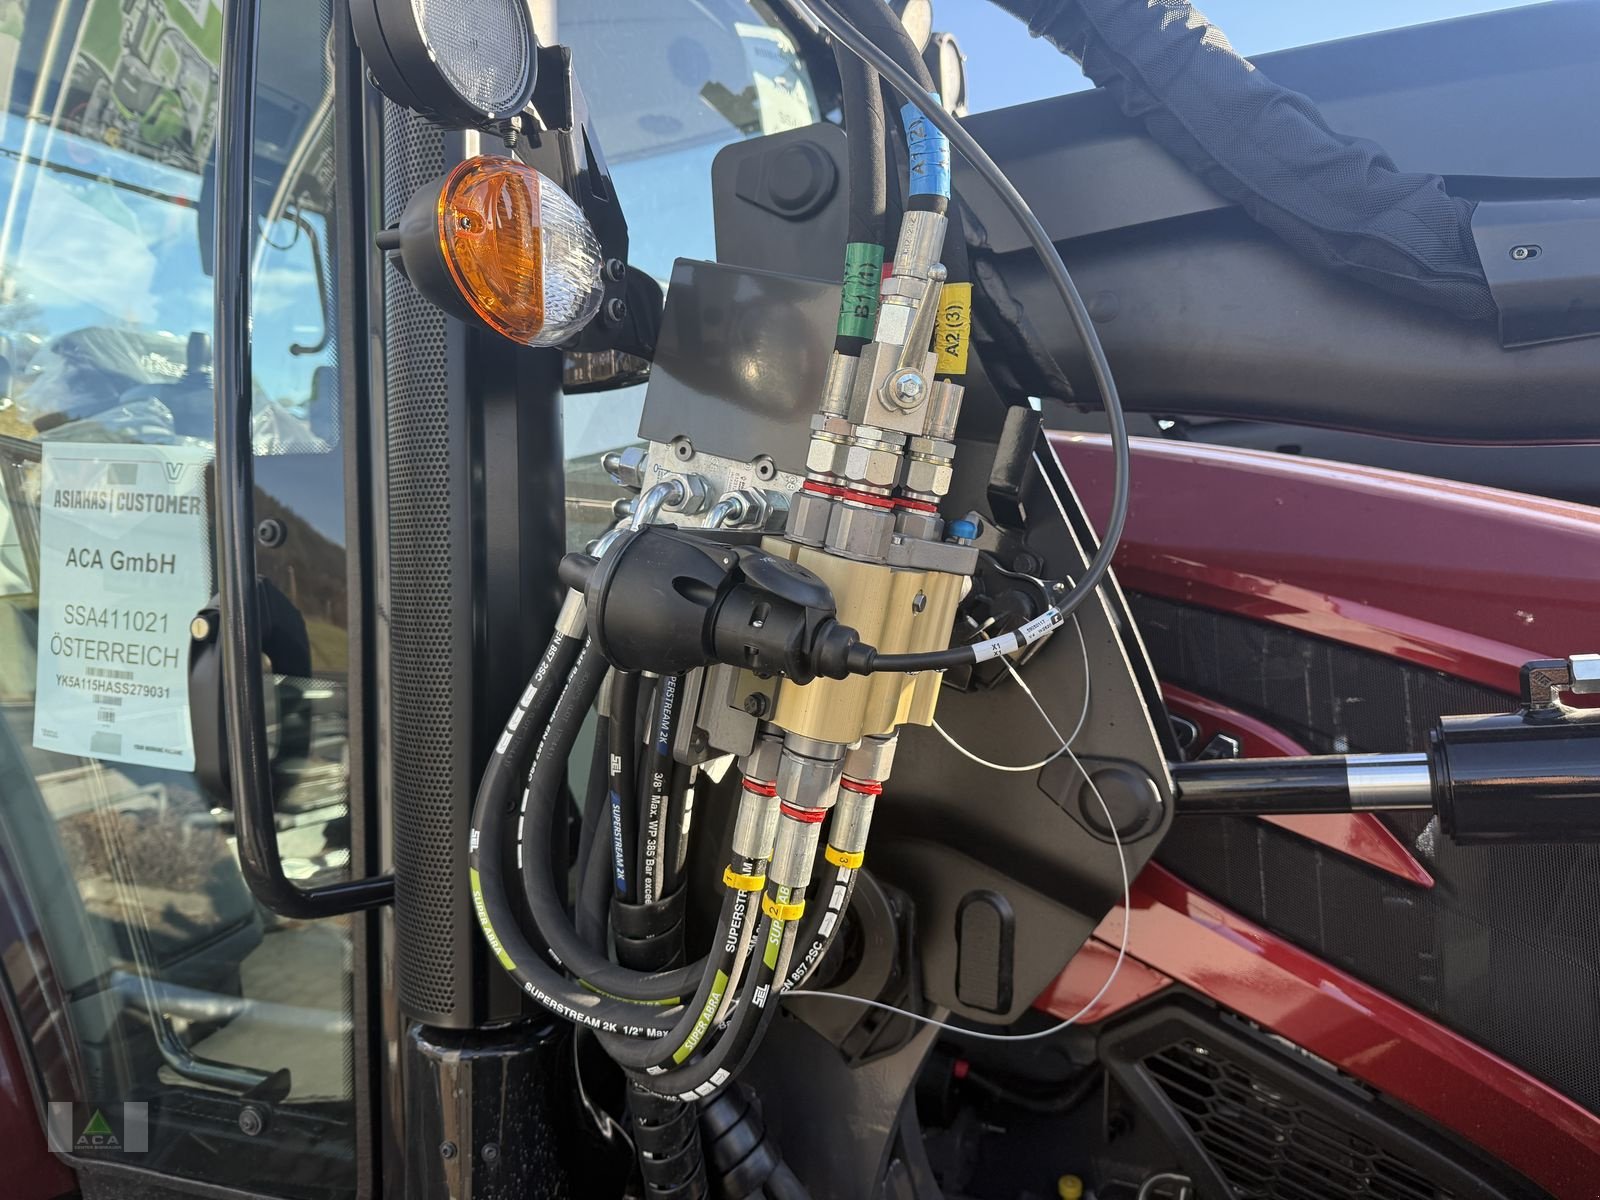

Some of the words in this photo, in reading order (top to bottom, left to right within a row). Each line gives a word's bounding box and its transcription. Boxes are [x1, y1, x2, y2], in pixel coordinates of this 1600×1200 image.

[910, 151, 925, 175] A1
[854, 294, 871, 319] B1
[945, 305, 964, 328] (3)
[945, 333, 960, 357] A2
[116, 492, 201, 515] CUSTOMER
[65, 547, 104, 569] ACA
[110, 550, 177, 574] GmbH
[63, 604, 168, 633] SSA411021
[50, 632, 179, 669] ÖSTERREICH
[546, 645, 558, 662] 857
[991, 642, 1002, 651] X1
[535, 661, 549, 682] 2SC
[661, 676, 677, 731] PERSTREAM
[659, 731, 669, 744] 2K
[610, 753, 622, 777] SEL
[653, 772, 664, 792] 3/8"
[649, 795, 661, 818] Max.
[613, 803, 624, 867] SUPERSTREAM
[648, 820, 658, 837] WP
[646, 839, 657, 857] 385
[616, 867, 626, 880] 2K
[645, 859, 655, 876] Bar
[644, 878, 653, 905] excee
[473, 890, 488, 925] SUPER
[484, 926, 502, 955] ABRA
[769, 906, 779, 916] 2
[791, 962, 808, 981] 857
[805, 941, 823, 964] 2SC
[752, 984, 770, 1008] SEL
[524, 981, 601, 1029] SUPERSTREAM
[602, 1021, 618, 1033] 2K
[623, 1026, 644, 1037] 1/2"
[685, 1020, 707, 1050] SUPER
[703, 992, 721, 1022] ABRA
